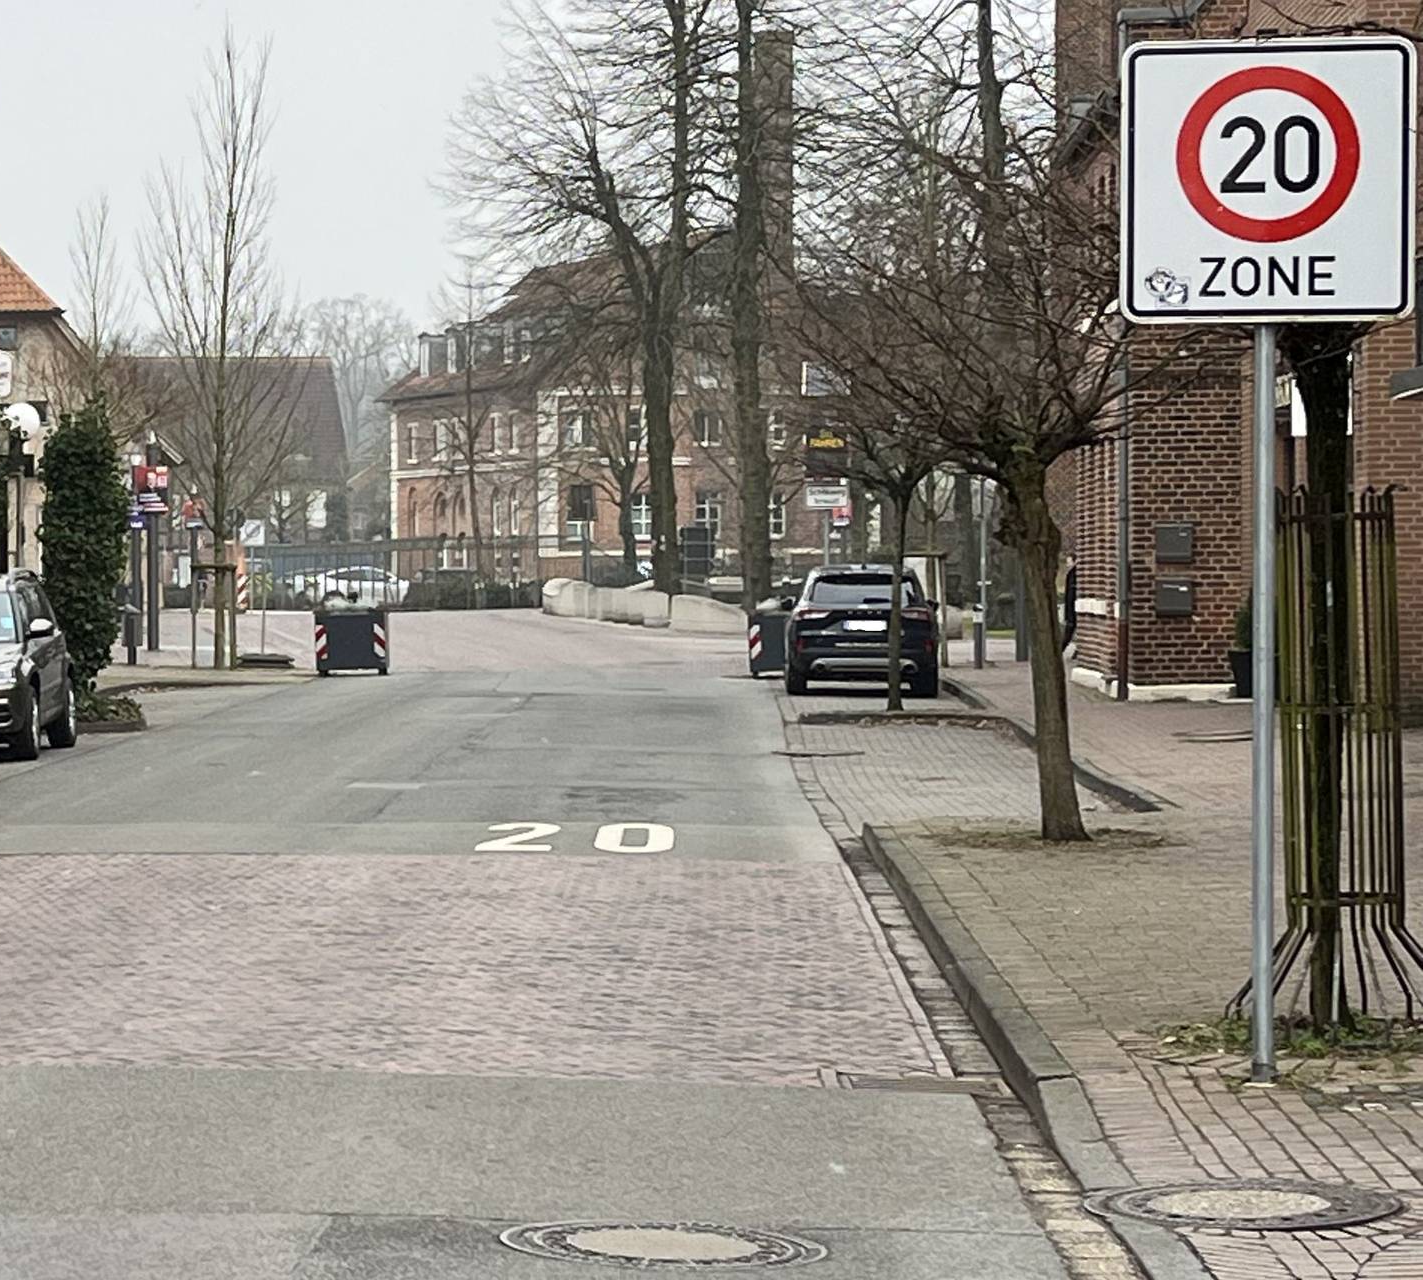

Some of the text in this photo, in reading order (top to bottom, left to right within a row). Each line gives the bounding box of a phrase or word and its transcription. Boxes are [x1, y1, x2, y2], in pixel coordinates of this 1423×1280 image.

[1220, 115, 1320, 193] 20
[1198, 255, 1336, 297] ZONE
[474, 821, 674, 853] 20
